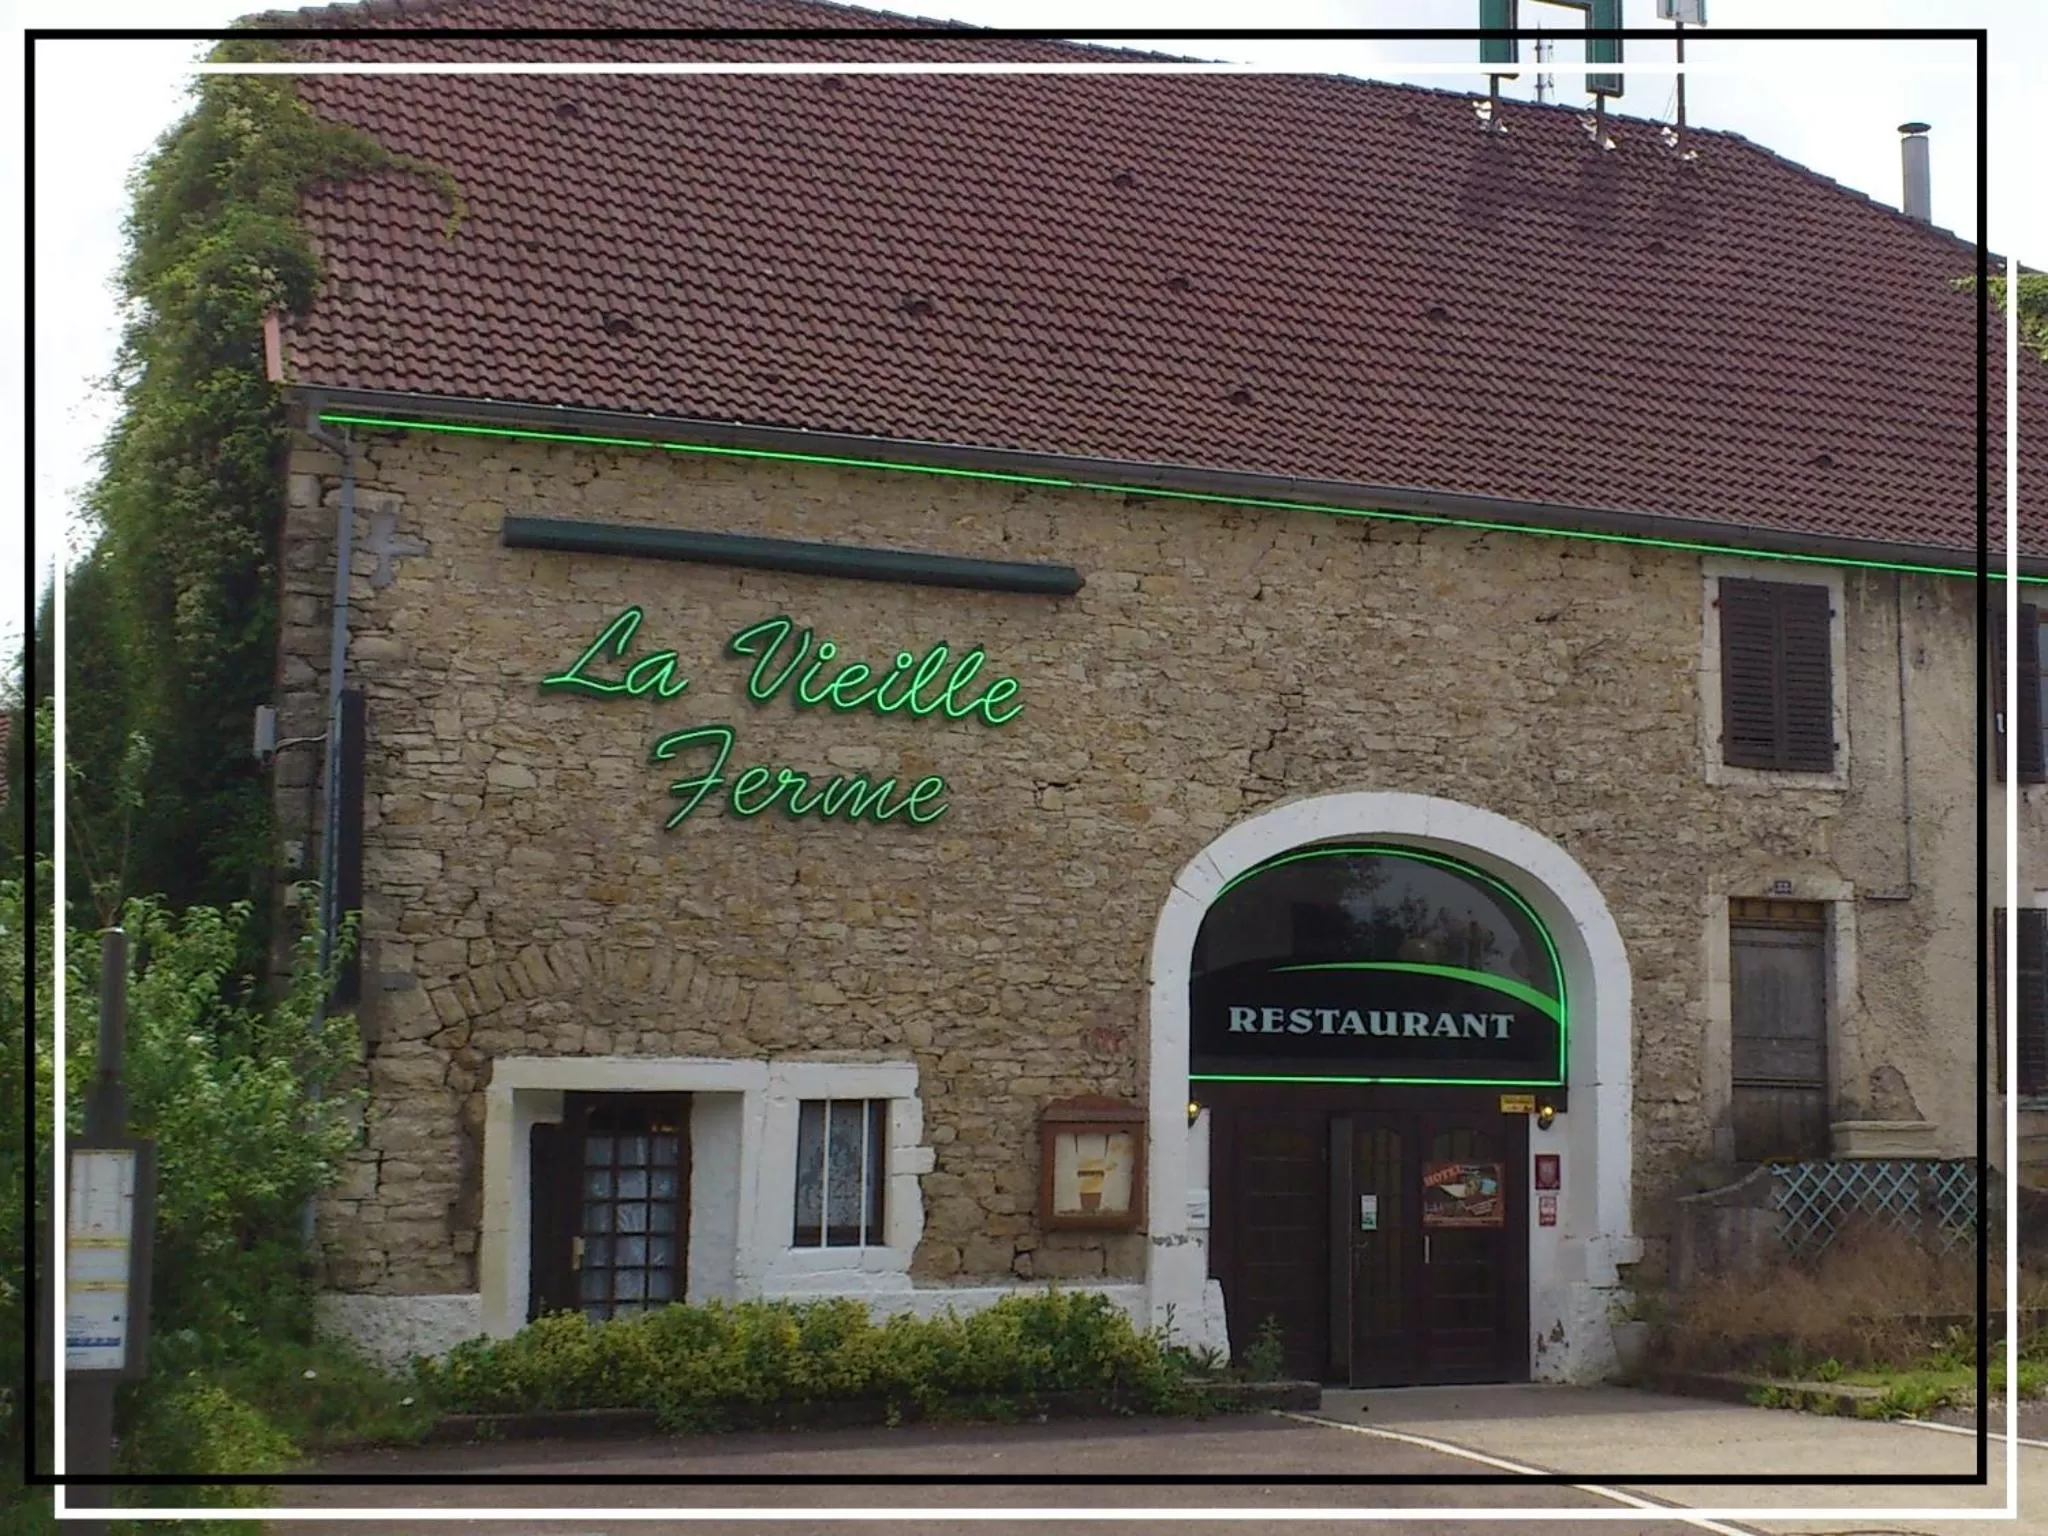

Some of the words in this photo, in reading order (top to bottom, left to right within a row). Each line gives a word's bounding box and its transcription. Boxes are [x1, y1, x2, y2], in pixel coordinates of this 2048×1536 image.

[541, 604, 690, 698] La
[729, 614, 1025, 726] Vieille
[651, 723, 952, 832] Ferme
[1228, 1006, 1515, 1039] RESTAURANT
